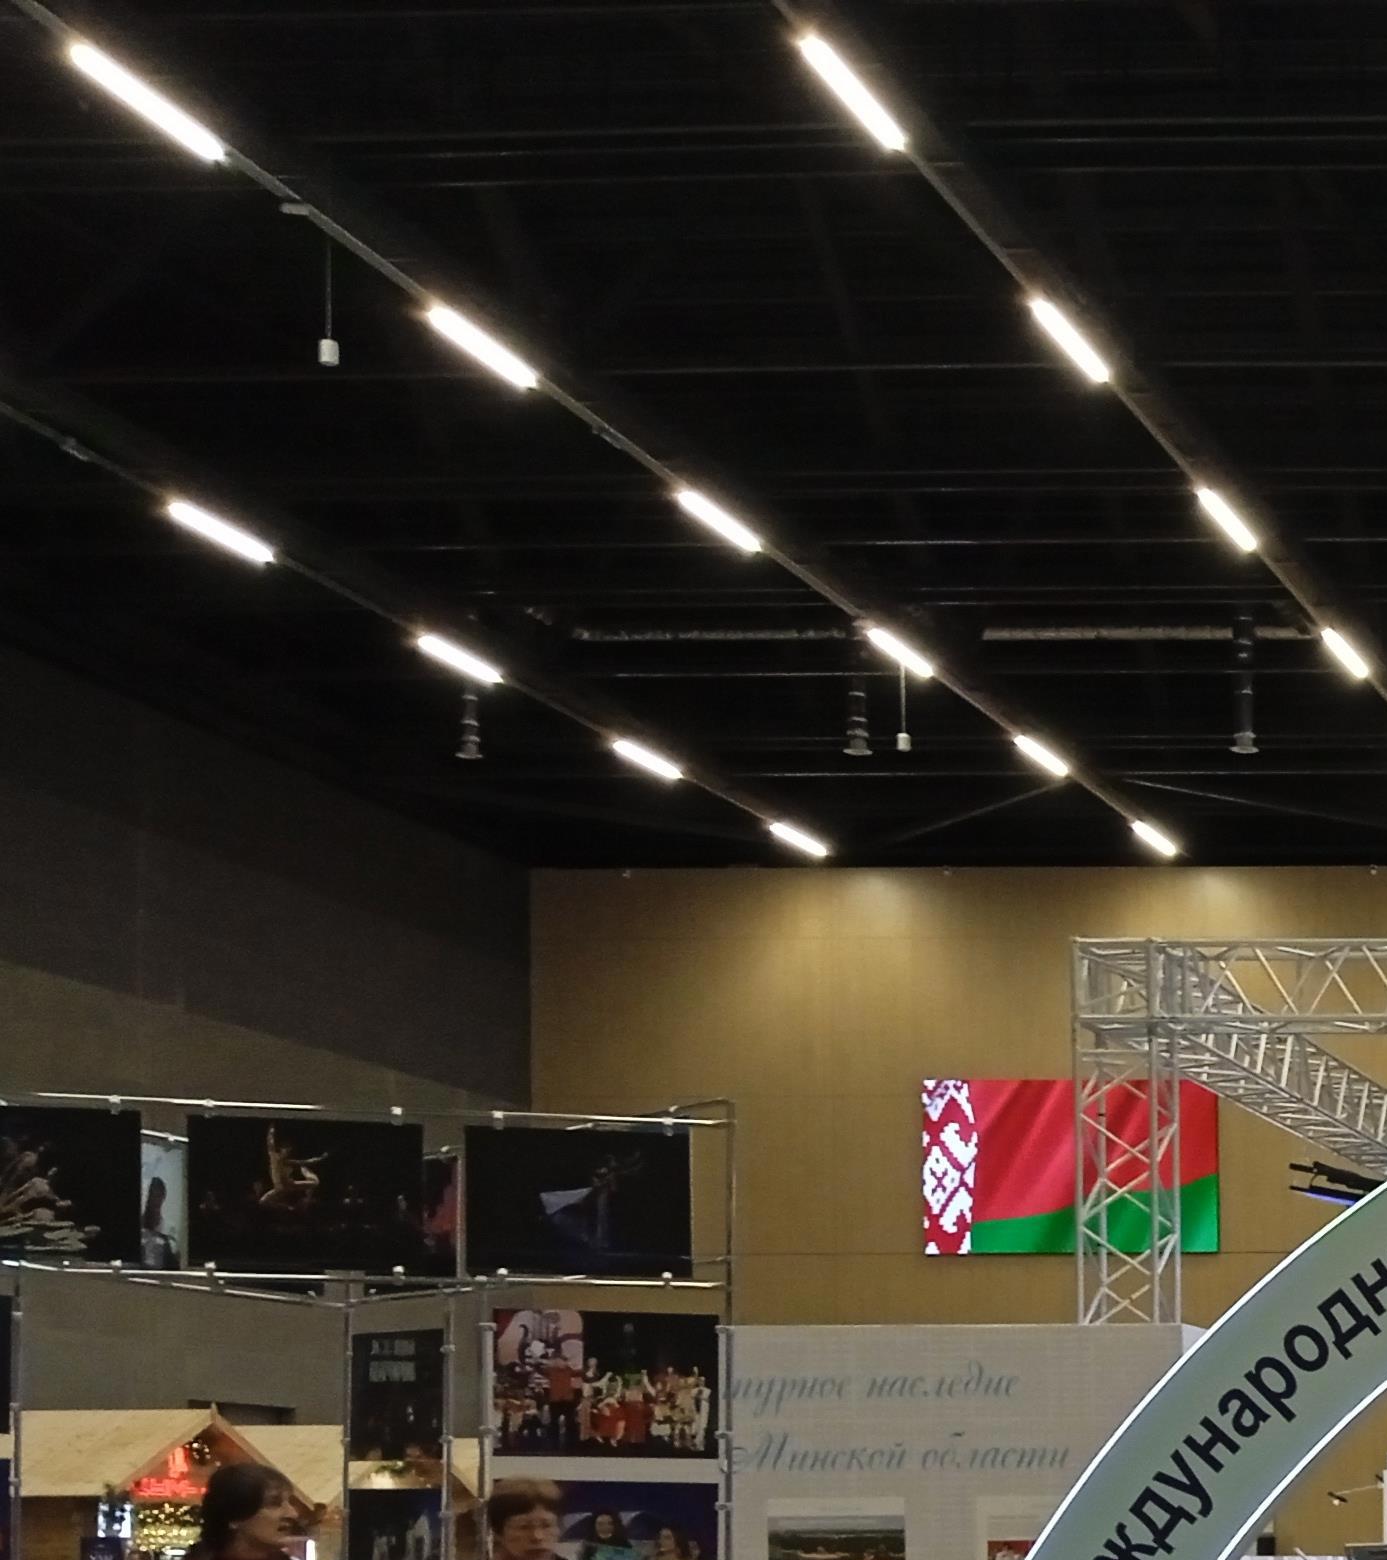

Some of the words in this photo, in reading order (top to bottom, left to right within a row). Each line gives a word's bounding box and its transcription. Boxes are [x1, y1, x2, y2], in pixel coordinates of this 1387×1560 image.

[726, 1375, 852, 1416] турное
[867, 1360, 1019, 1399] наследие
[732, 1432, 908, 1472] Минской
[922, 1432, 1071, 1471] области
